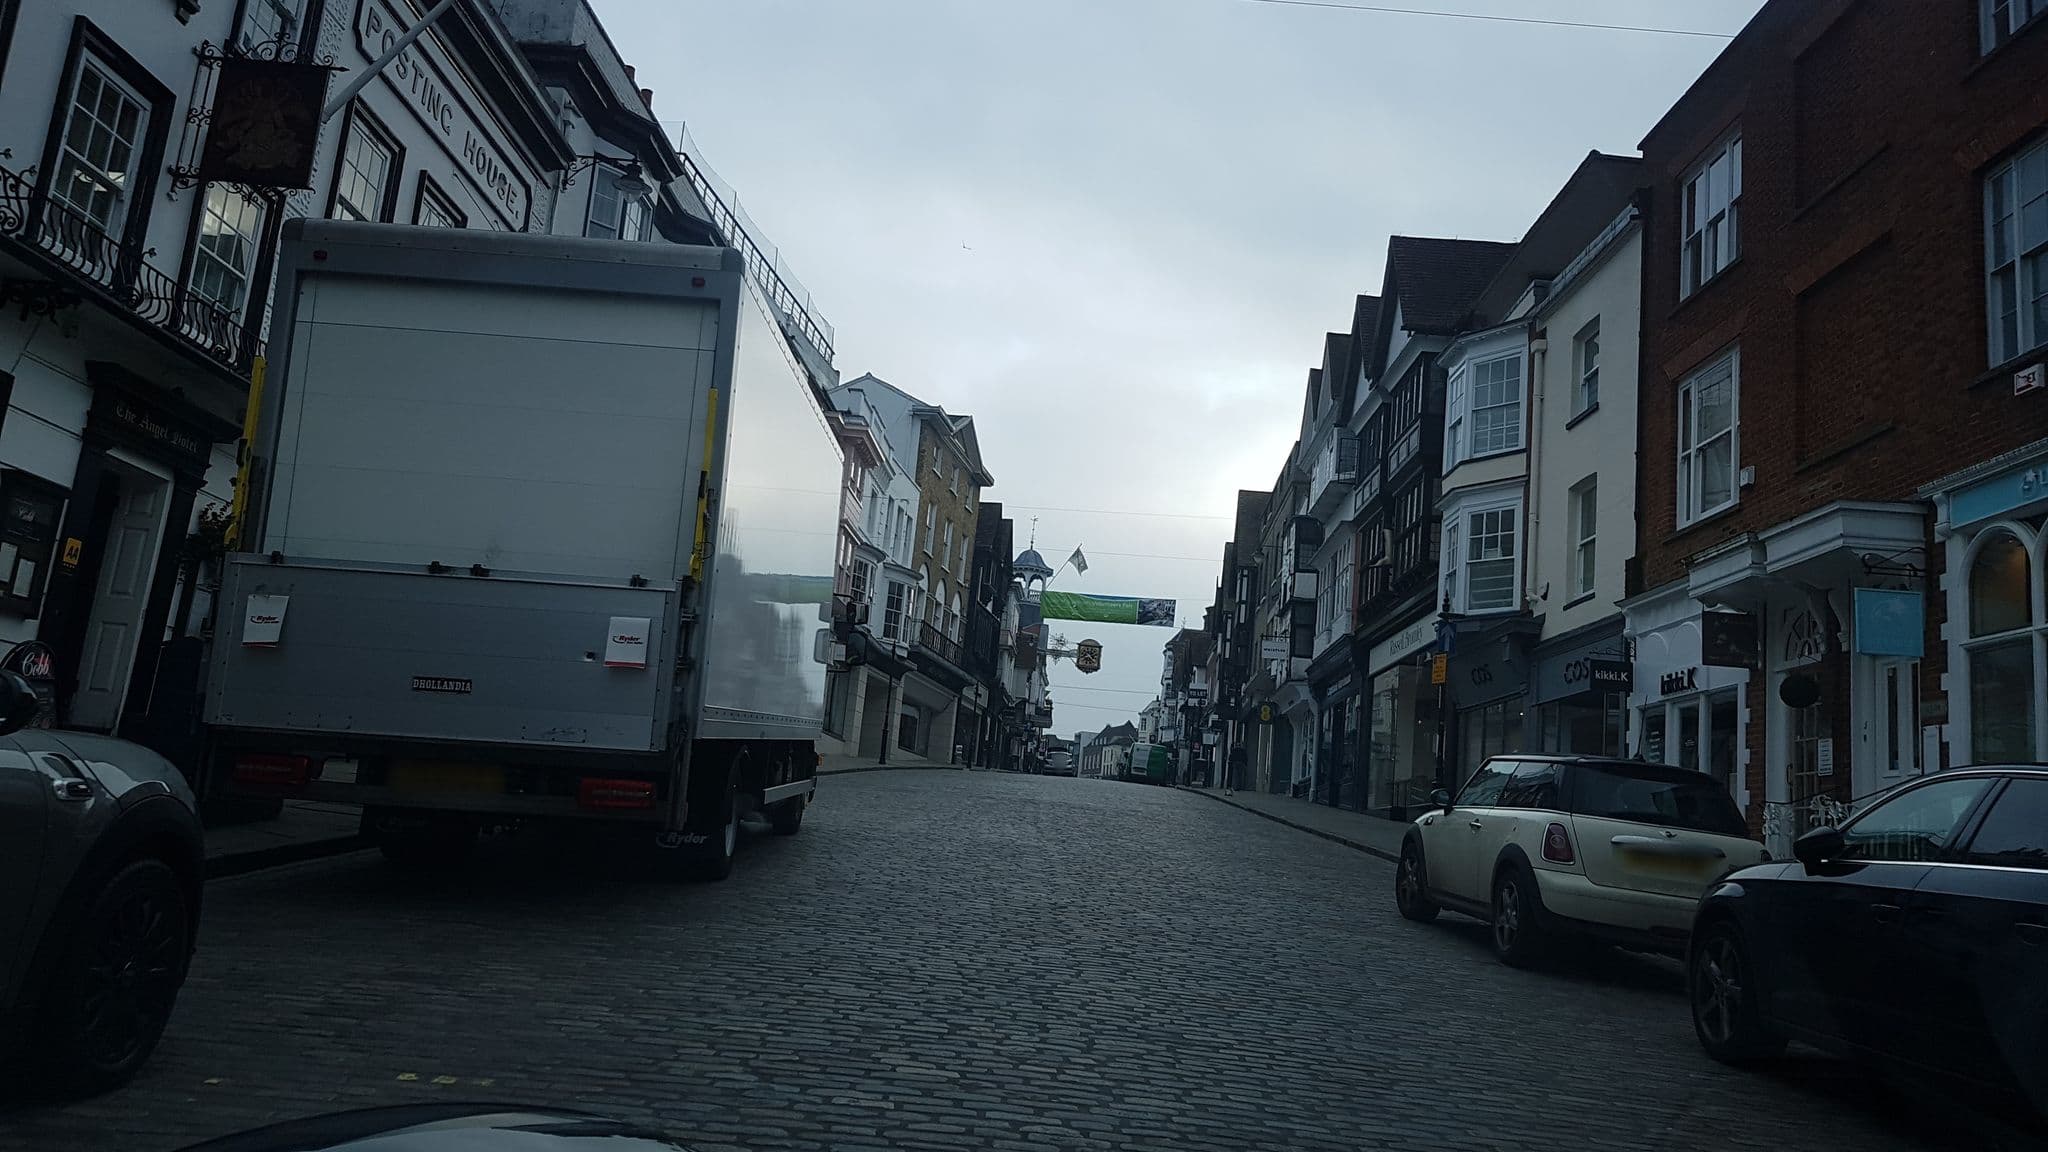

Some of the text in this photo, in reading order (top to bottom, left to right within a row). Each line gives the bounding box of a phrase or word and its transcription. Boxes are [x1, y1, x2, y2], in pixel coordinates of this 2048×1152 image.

[366, 6, 453, 136] POSTING
[116, 405, 137, 424] The
[138, 415, 169, 440] Angel
[66, 544, 79, 558] AA
[1595, 669, 1629, 682] kikki.K
[412, 678, 471, 692] DHOLLANDIA
